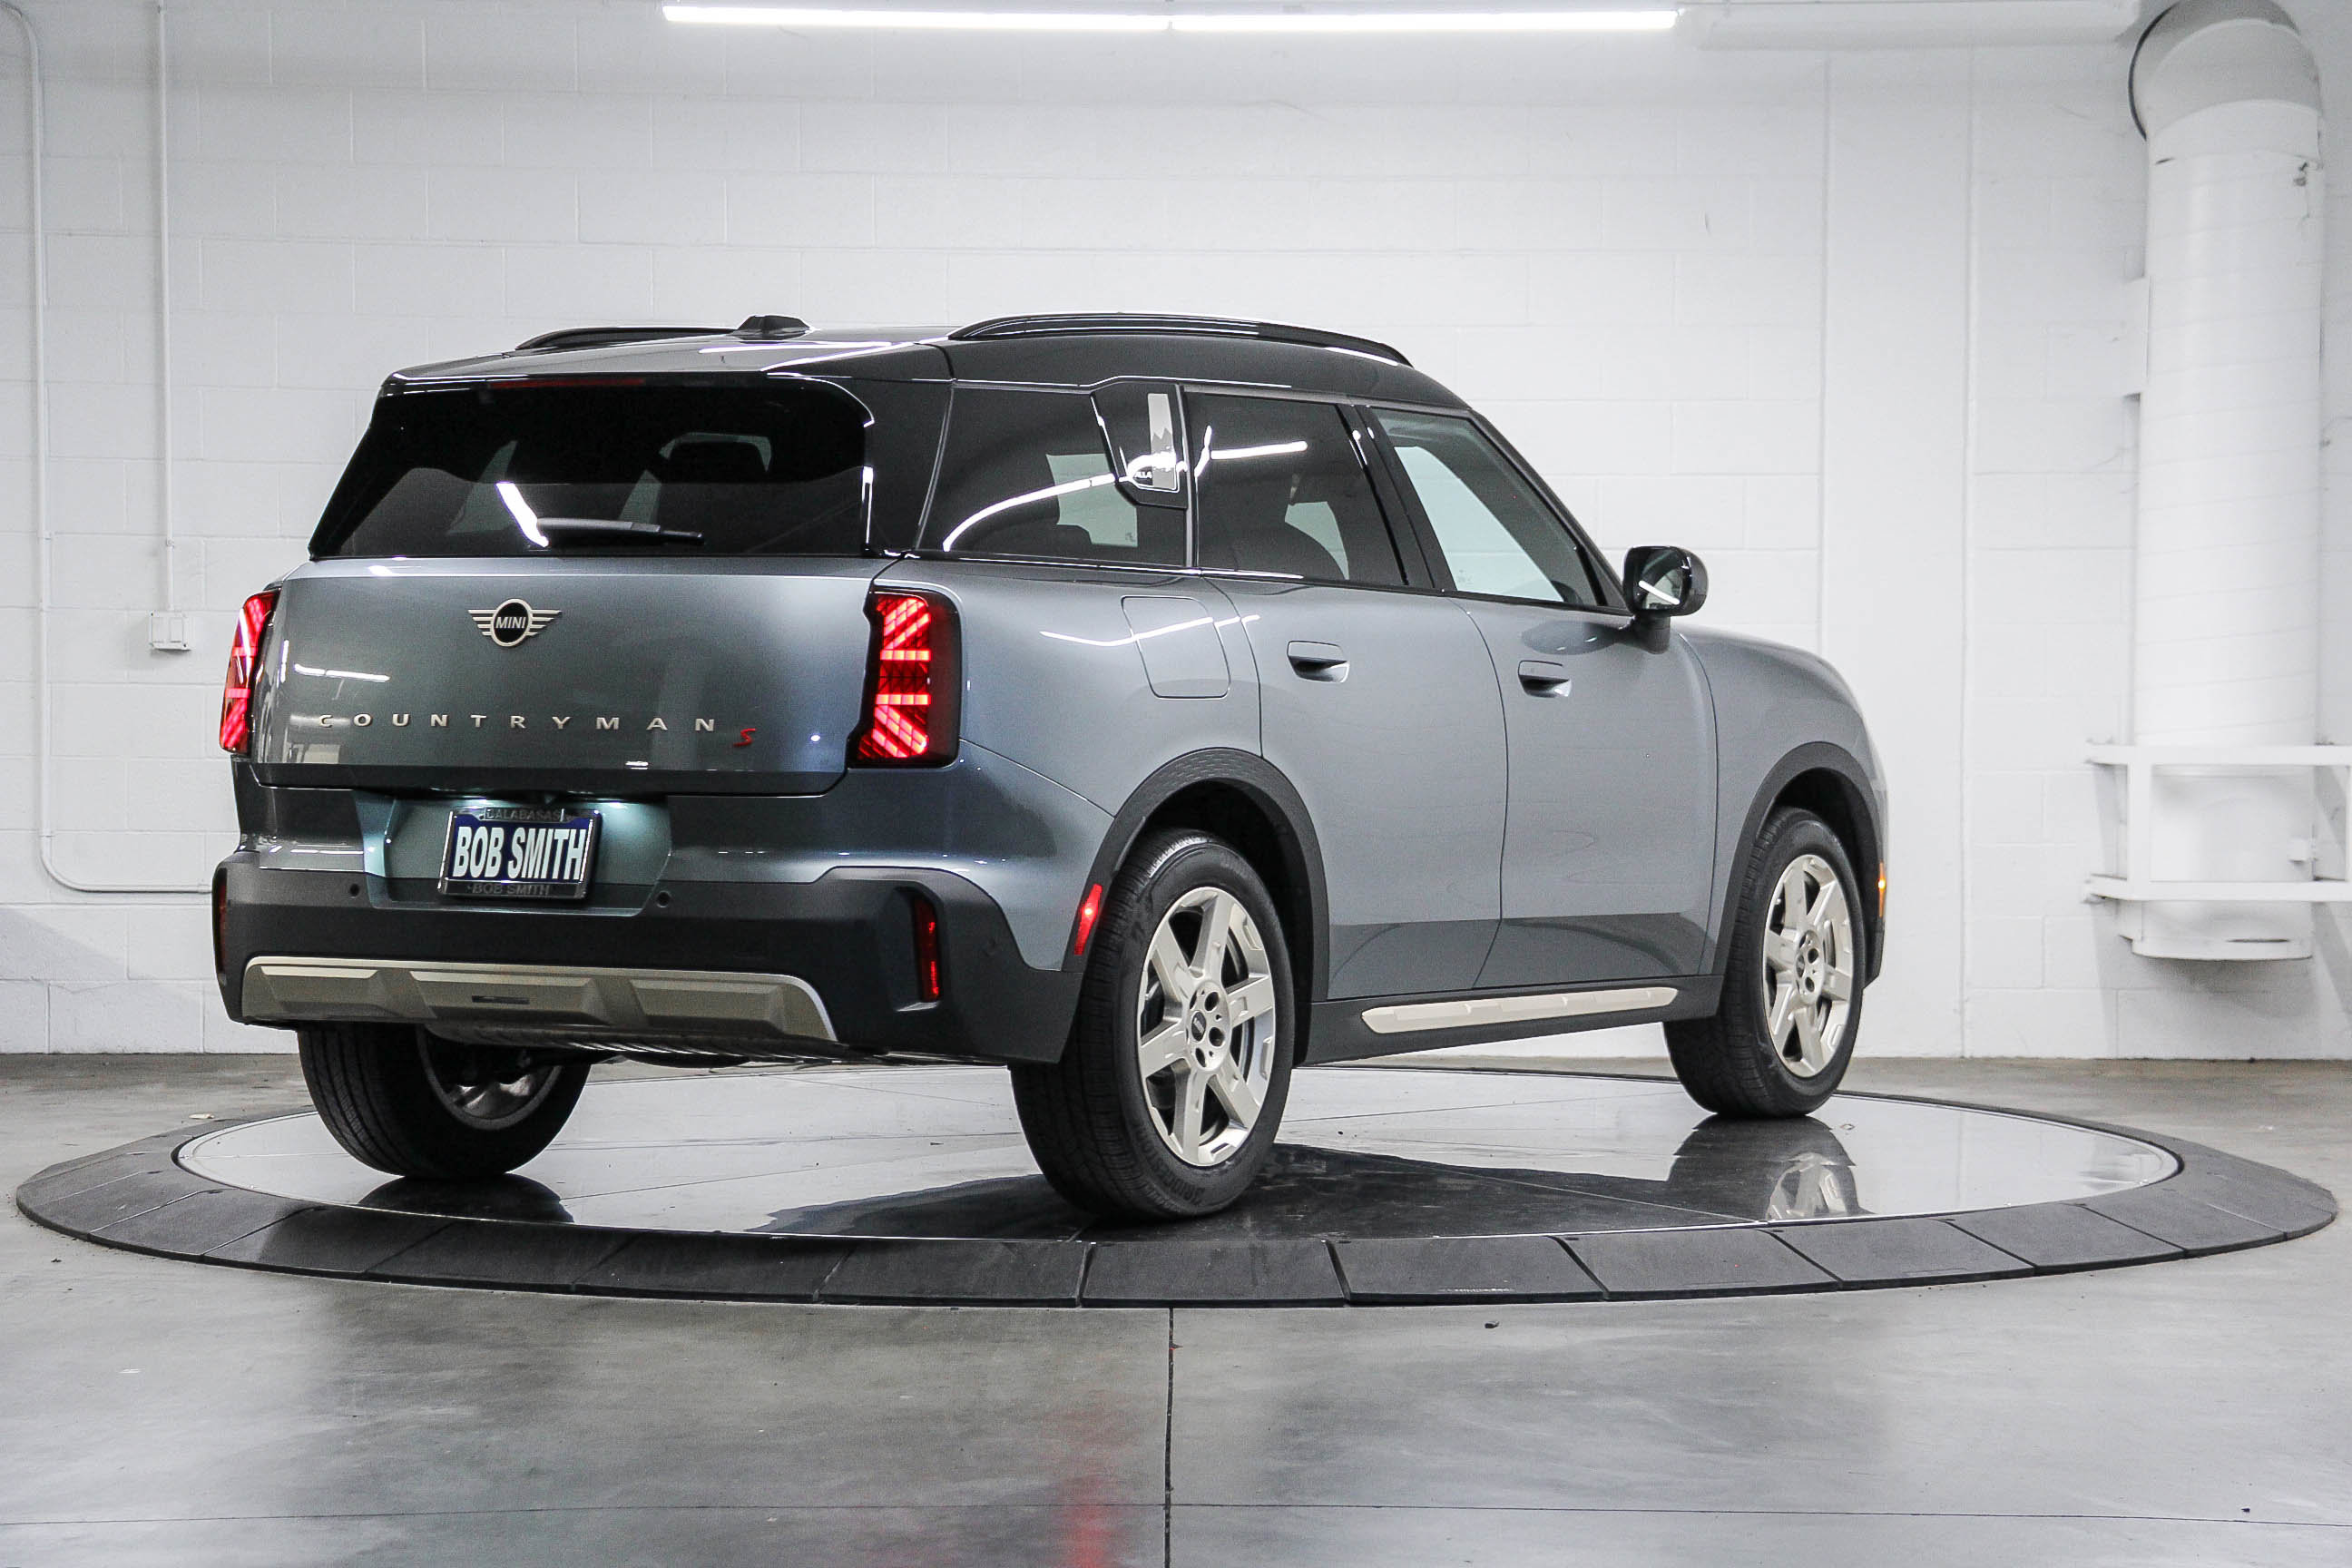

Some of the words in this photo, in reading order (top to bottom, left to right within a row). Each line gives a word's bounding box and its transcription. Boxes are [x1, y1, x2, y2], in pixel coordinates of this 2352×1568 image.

[495, 617, 526, 628] MINI
[318, 713, 715, 731] COUNTRYMAN
[732, 728, 756, 746] S
[453, 826, 505, 877] BOB
[507, 827, 586, 879] SMITH
[472, 883, 503, 894] BOB
[506, 884, 550, 896] SMITH
